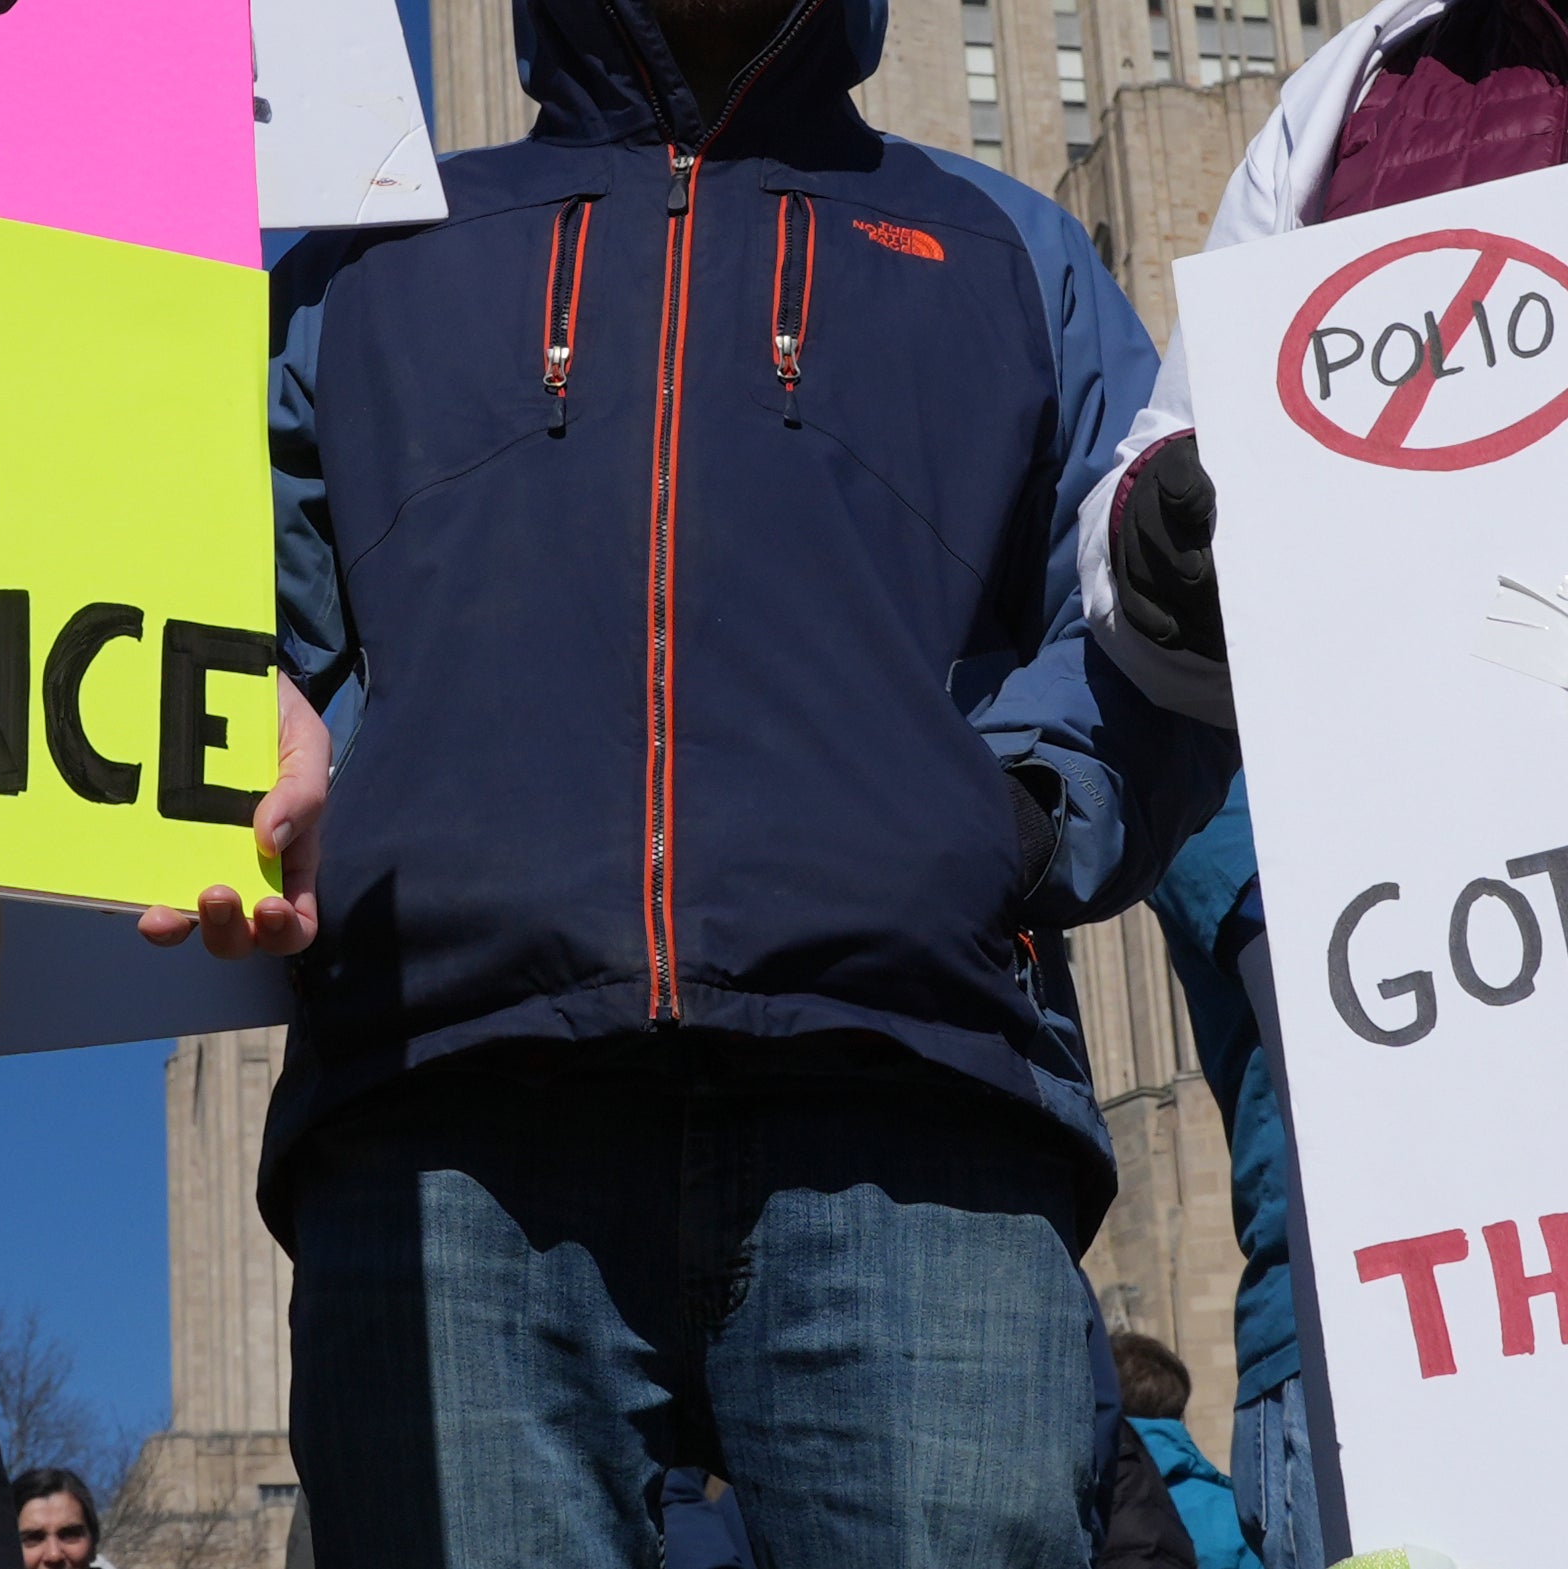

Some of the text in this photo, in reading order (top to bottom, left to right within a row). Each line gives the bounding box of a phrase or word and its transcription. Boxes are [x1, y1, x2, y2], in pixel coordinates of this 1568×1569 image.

[852, 219, 911, 245] NORTH
[878, 220, 913, 237] THE
[868, 232, 913, 255] FACE
[1311, 291, 1555, 400] POLIO
